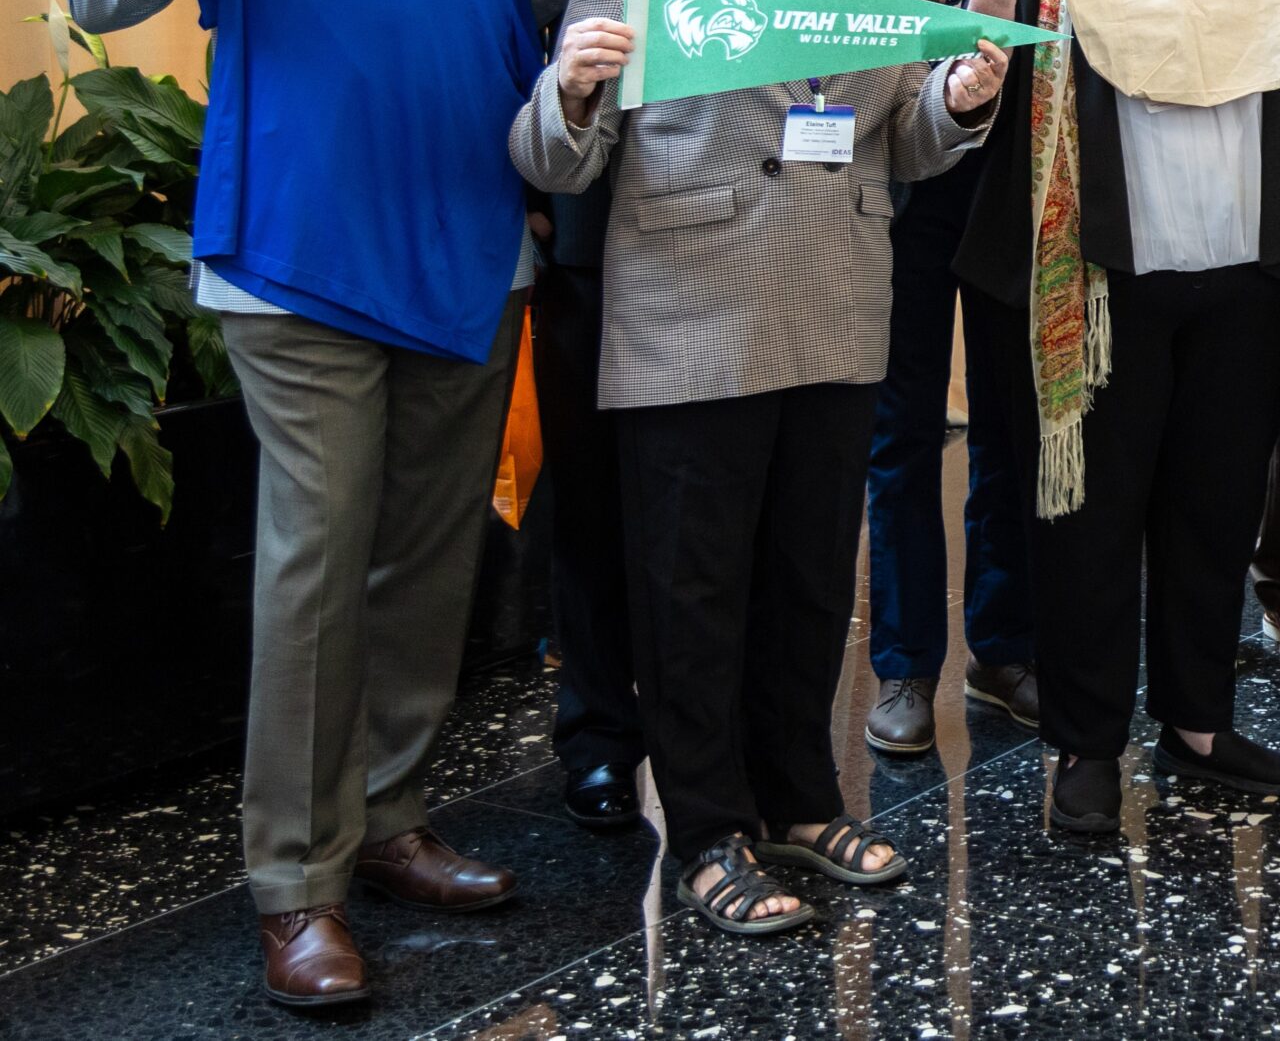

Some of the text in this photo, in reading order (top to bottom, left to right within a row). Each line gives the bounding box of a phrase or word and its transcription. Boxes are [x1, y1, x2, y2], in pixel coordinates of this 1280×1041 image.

[773, 10, 931, 35] UTAH VALLEY
[799, 34, 898, 47] WOLVERINES
